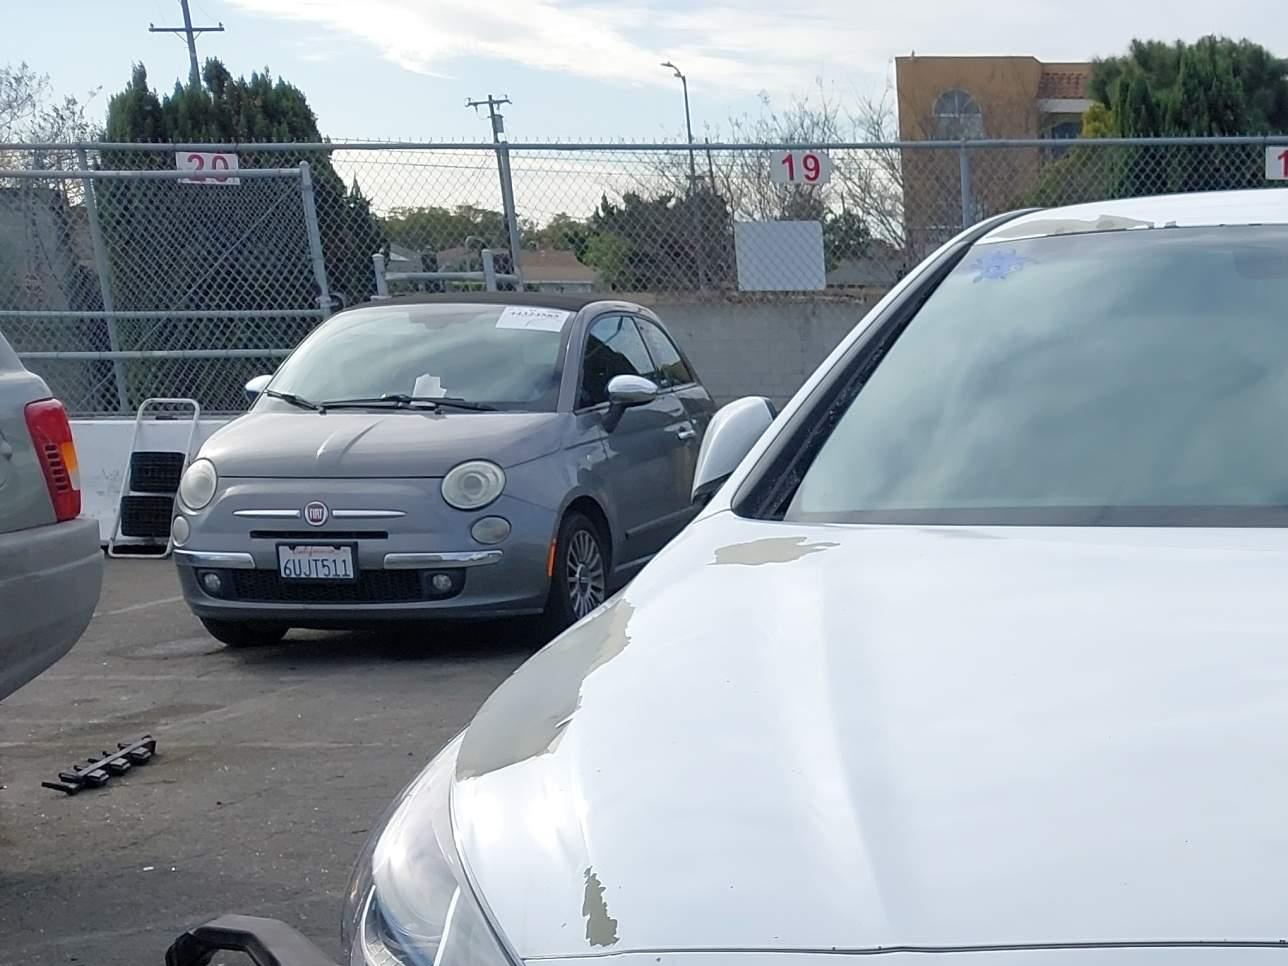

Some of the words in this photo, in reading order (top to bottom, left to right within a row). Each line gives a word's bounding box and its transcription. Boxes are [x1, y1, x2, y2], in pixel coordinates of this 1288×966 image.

[187, 154, 229, 182] 20
[782, 154, 821, 181] 19
[283, 559, 351, 577] 6UJT511
